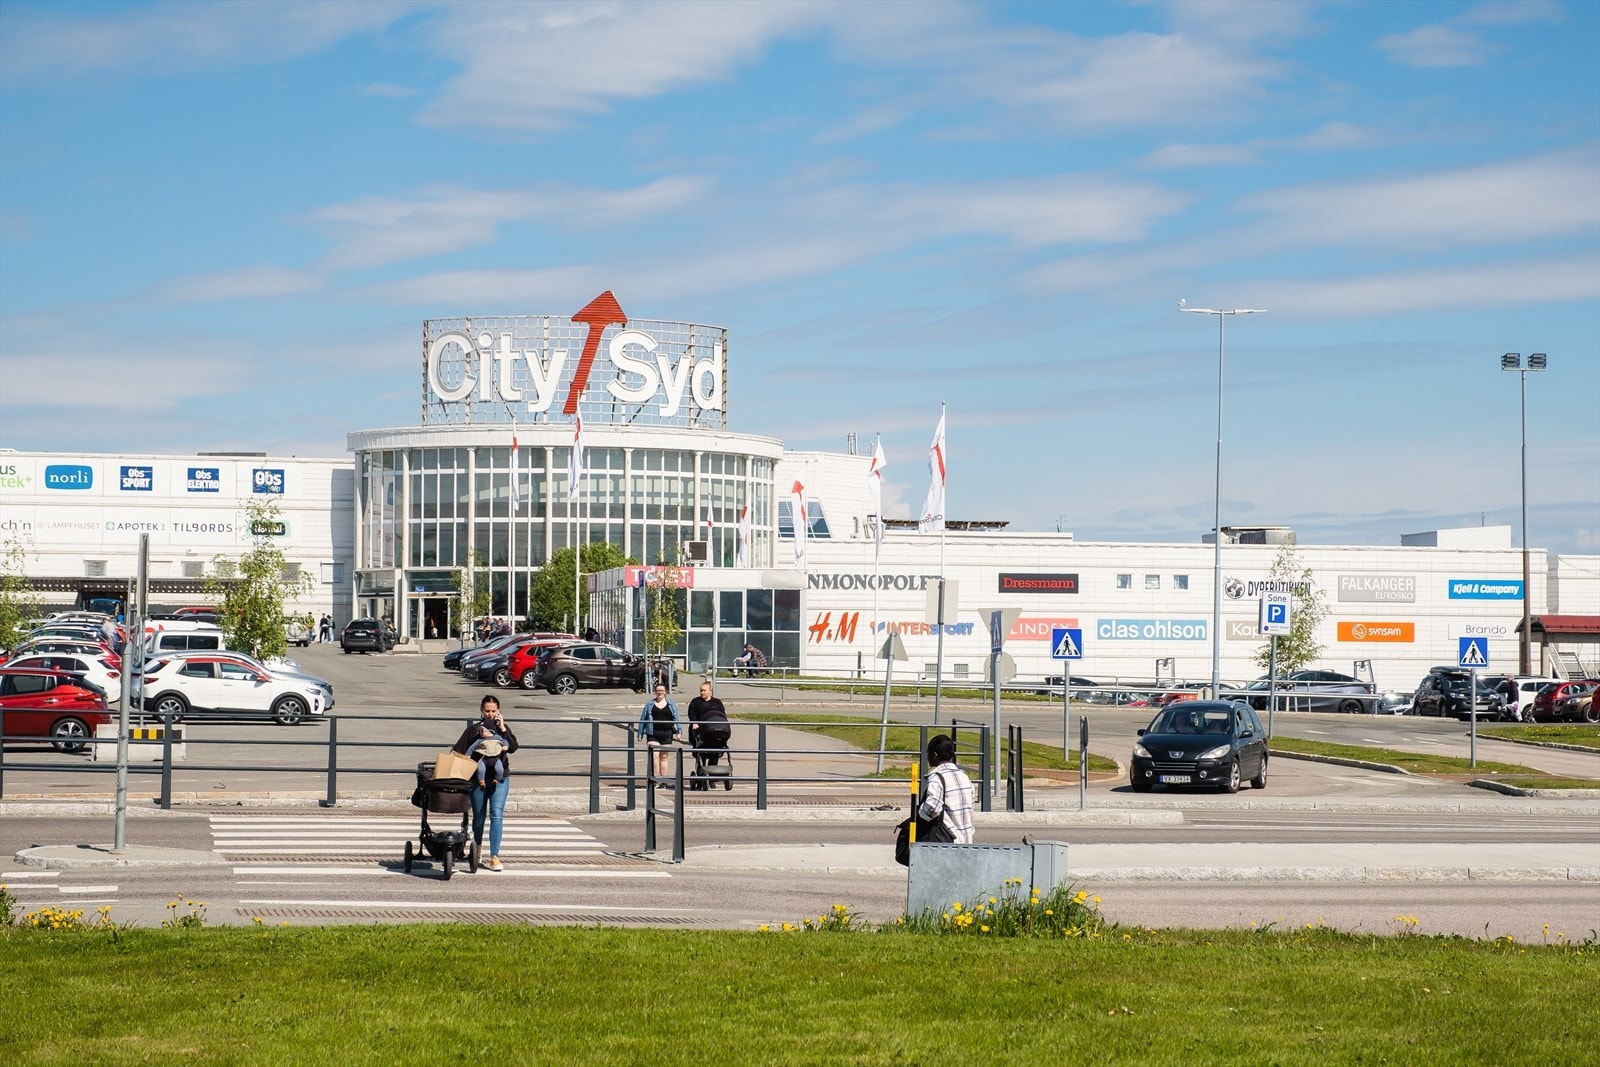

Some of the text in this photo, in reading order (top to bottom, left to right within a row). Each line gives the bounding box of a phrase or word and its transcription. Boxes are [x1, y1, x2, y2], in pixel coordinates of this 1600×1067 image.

[428, 330, 722, 417] City Syd
[49, 470, 89, 483] norli
[122, 478, 151, 488] SPORT
[188, 479, 220, 489] ELEKTRO
[47, 522, 101, 530] LAMPEHUSET
[117, 522, 159, 530] APOTEK
[173, 523, 233, 533] TILBORDS
[807, 573, 942, 591] NMONOPOLE
[1003, 578, 1075, 589] Dressmann
[1342, 577, 1414, 591] FALKANGER
[1453, 584, 1520, 595] Kjell & Company
[1267, 594, 1287, 603] Sone
[1375, 591, 1414, 600] EUROSKO
[1272, 606, 1282, 621] P
[808, 612, 860, 644] H&M
[887, 622, 975, 635] INTERSORT
[1099, 620, 1206, 639] clas ohlson
[1465, 625, 1507, 635] Brando
